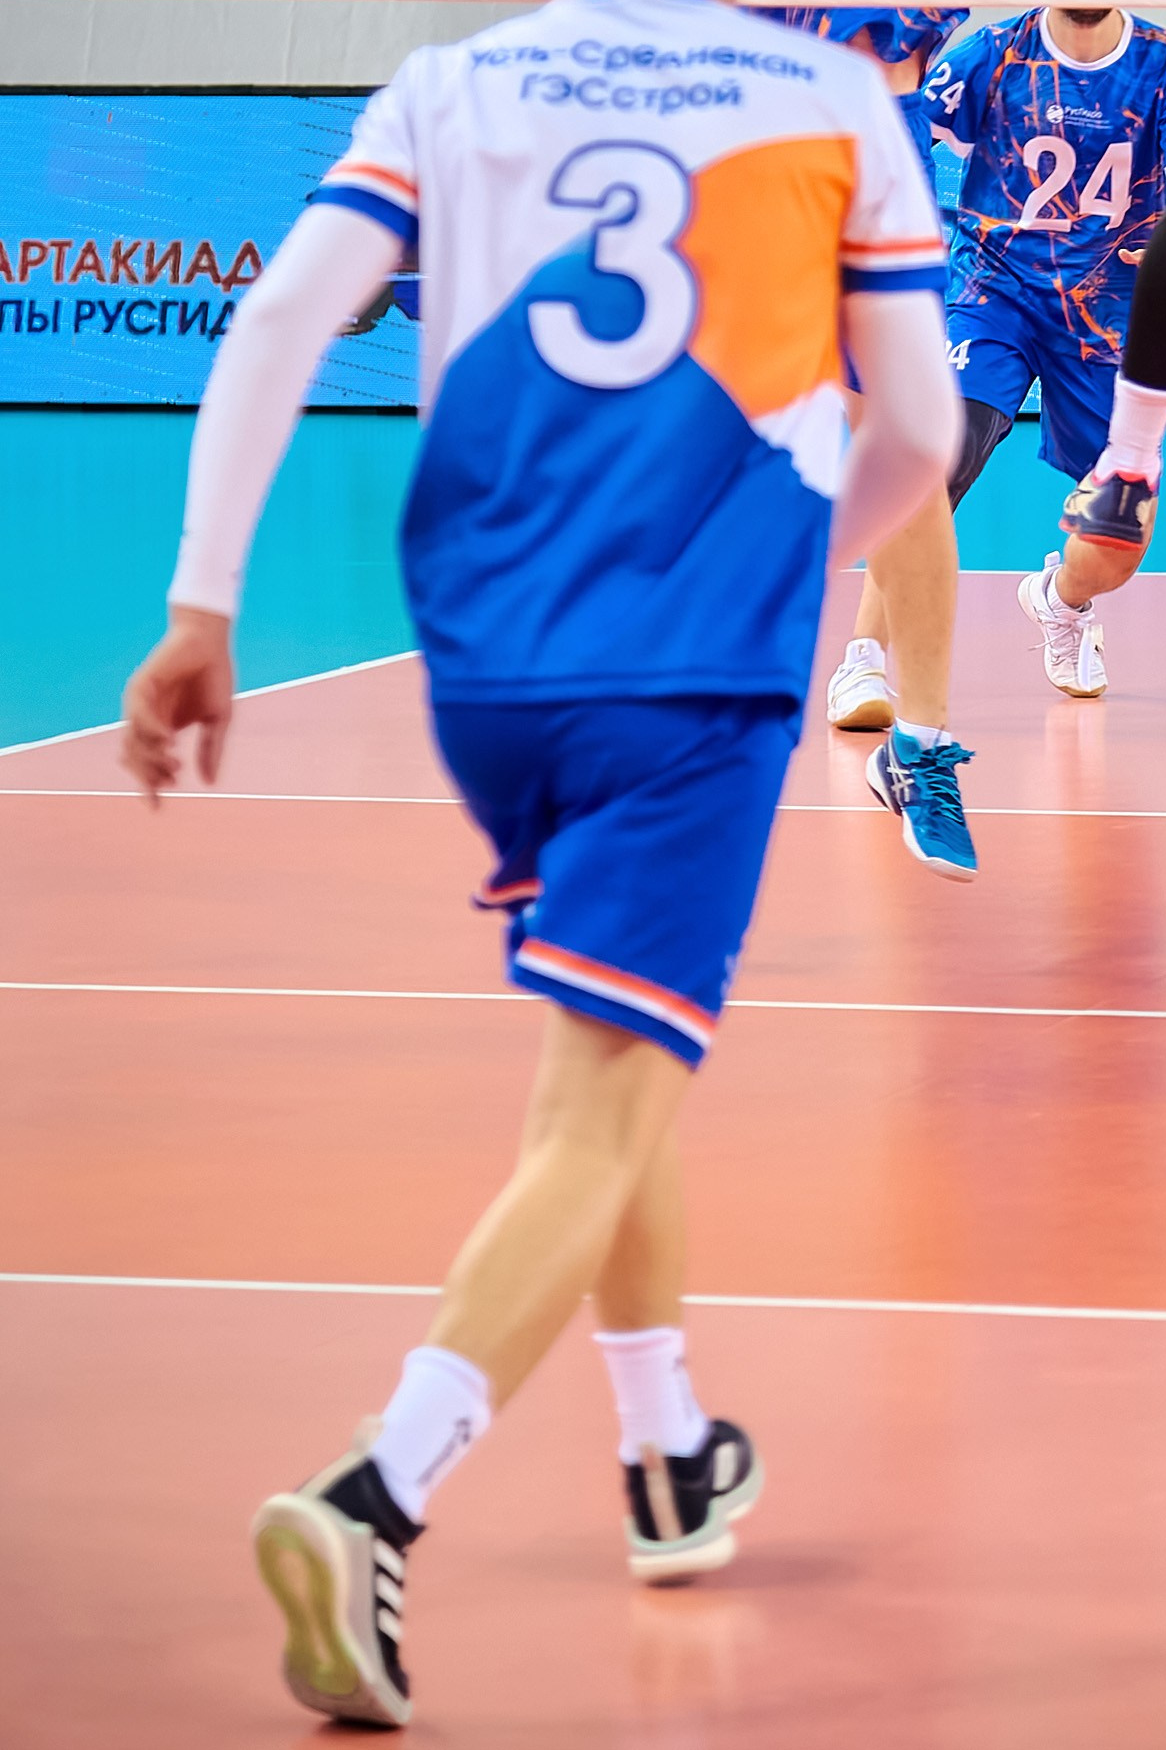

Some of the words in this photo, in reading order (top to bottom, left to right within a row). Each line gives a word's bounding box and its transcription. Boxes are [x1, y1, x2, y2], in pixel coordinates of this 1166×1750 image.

[520, 73, 742, 115] ГЭСстрой
[924, 61, 965, 115] 24
[1017, 135, 1133, 232] 24
[0, 239, 265, 293] РТАКИАД
[527, 138, 704, 391] 3
[74, 299, 238, 342] РУСГИД
[945, 339, 972, 370] 4
